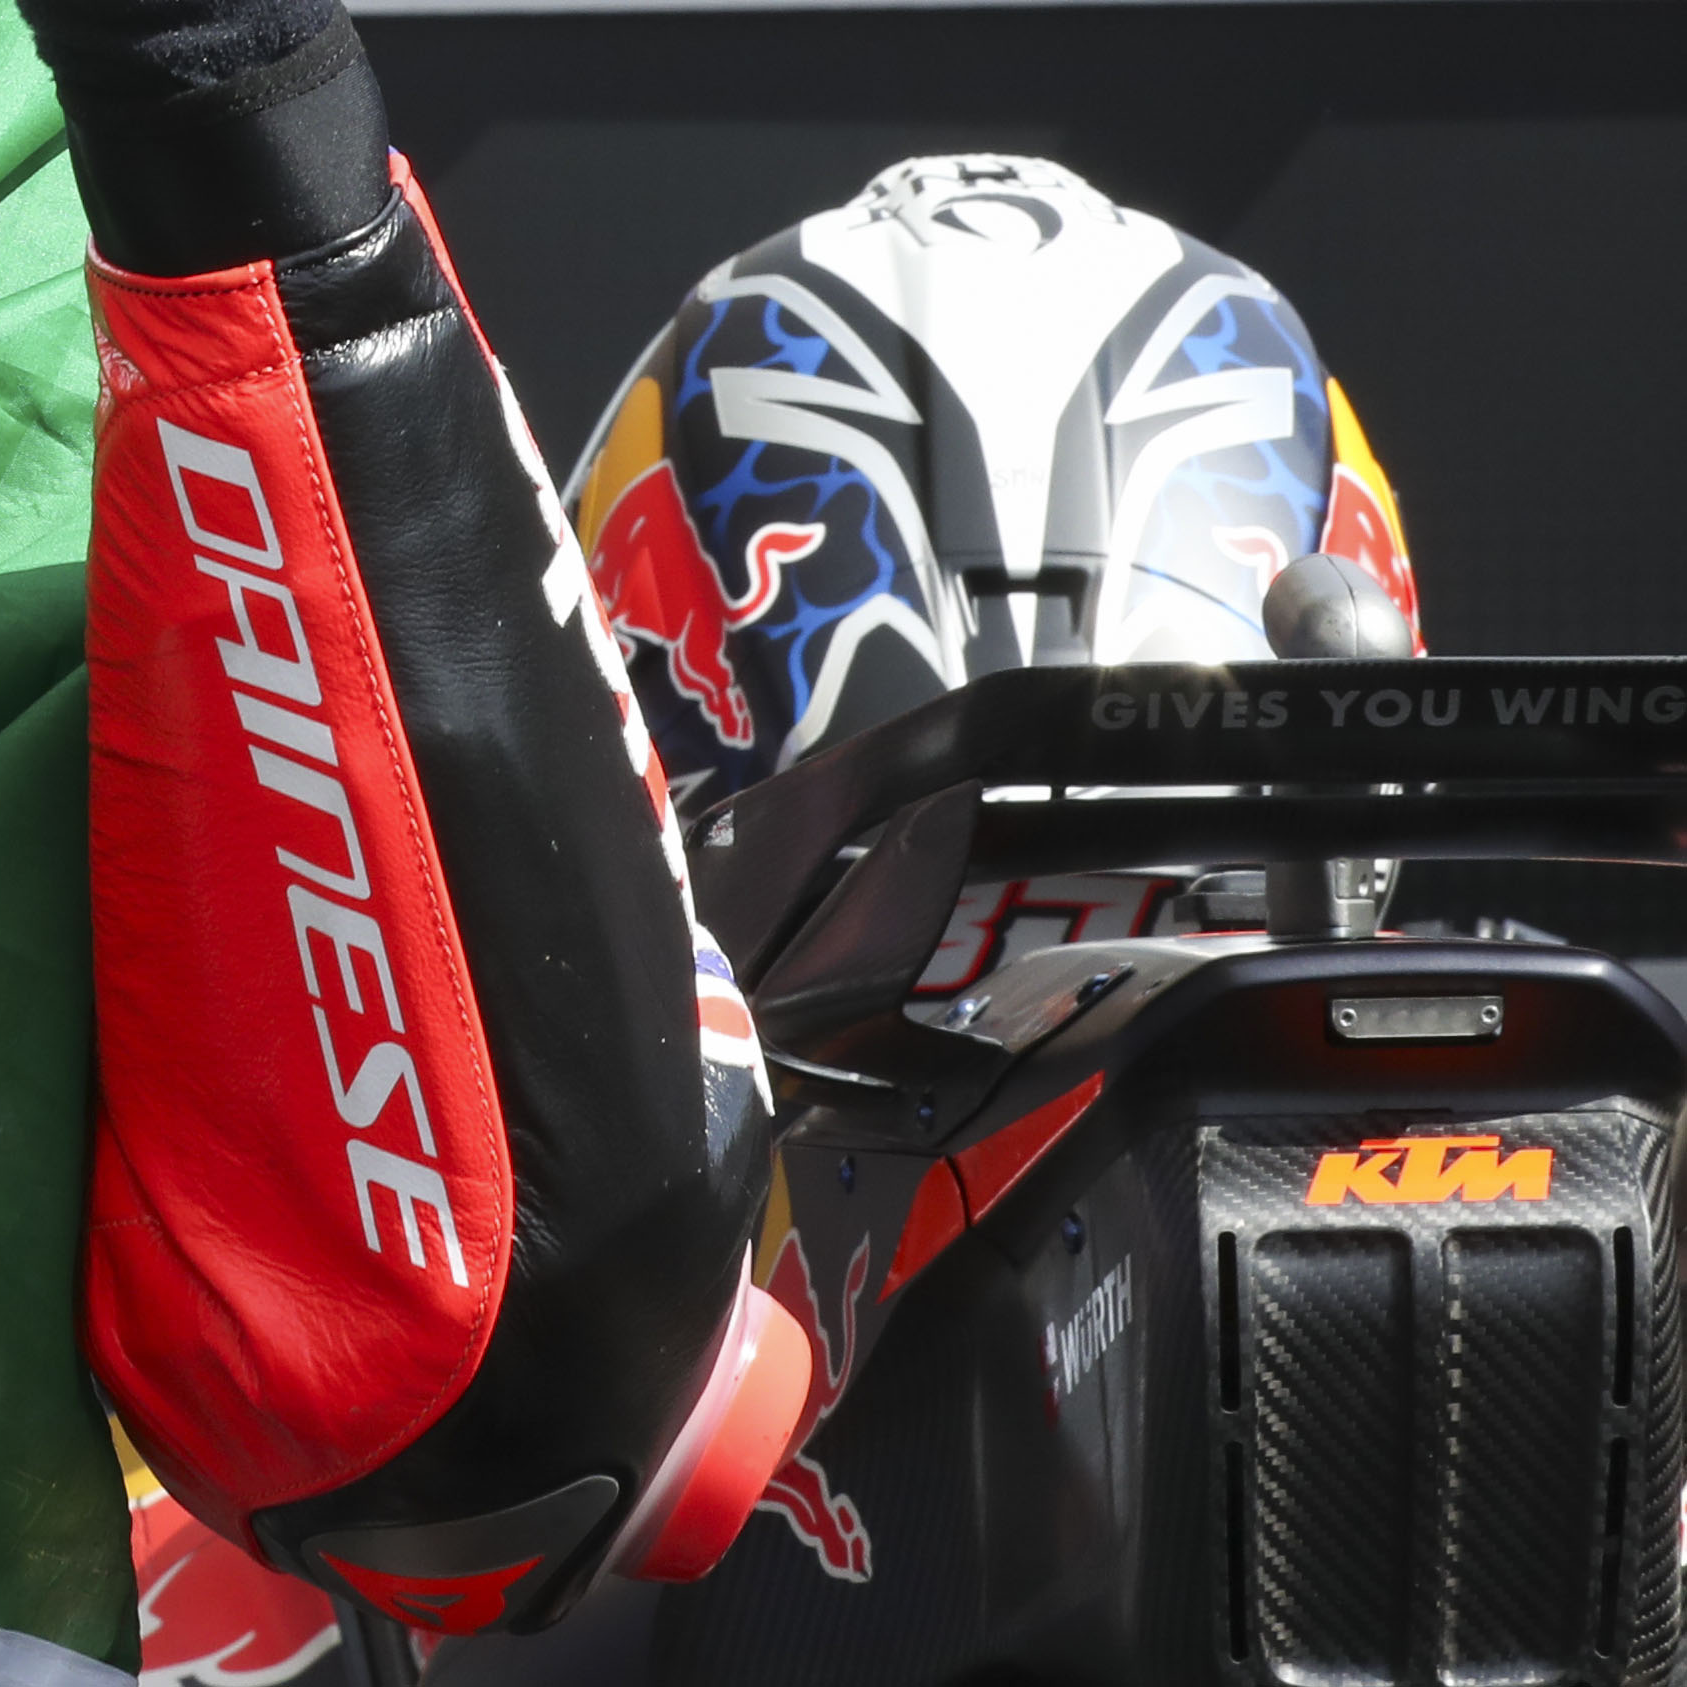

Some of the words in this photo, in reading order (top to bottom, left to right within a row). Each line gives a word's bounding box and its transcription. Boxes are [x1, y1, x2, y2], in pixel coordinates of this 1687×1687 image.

[1091, 690, 1290, 730] GIVES
[1319, 687, 1462, 728] YOU
[156, 417, 469, 1290] DAINESE
[1303, 1134, 1554, 1206] KTM
